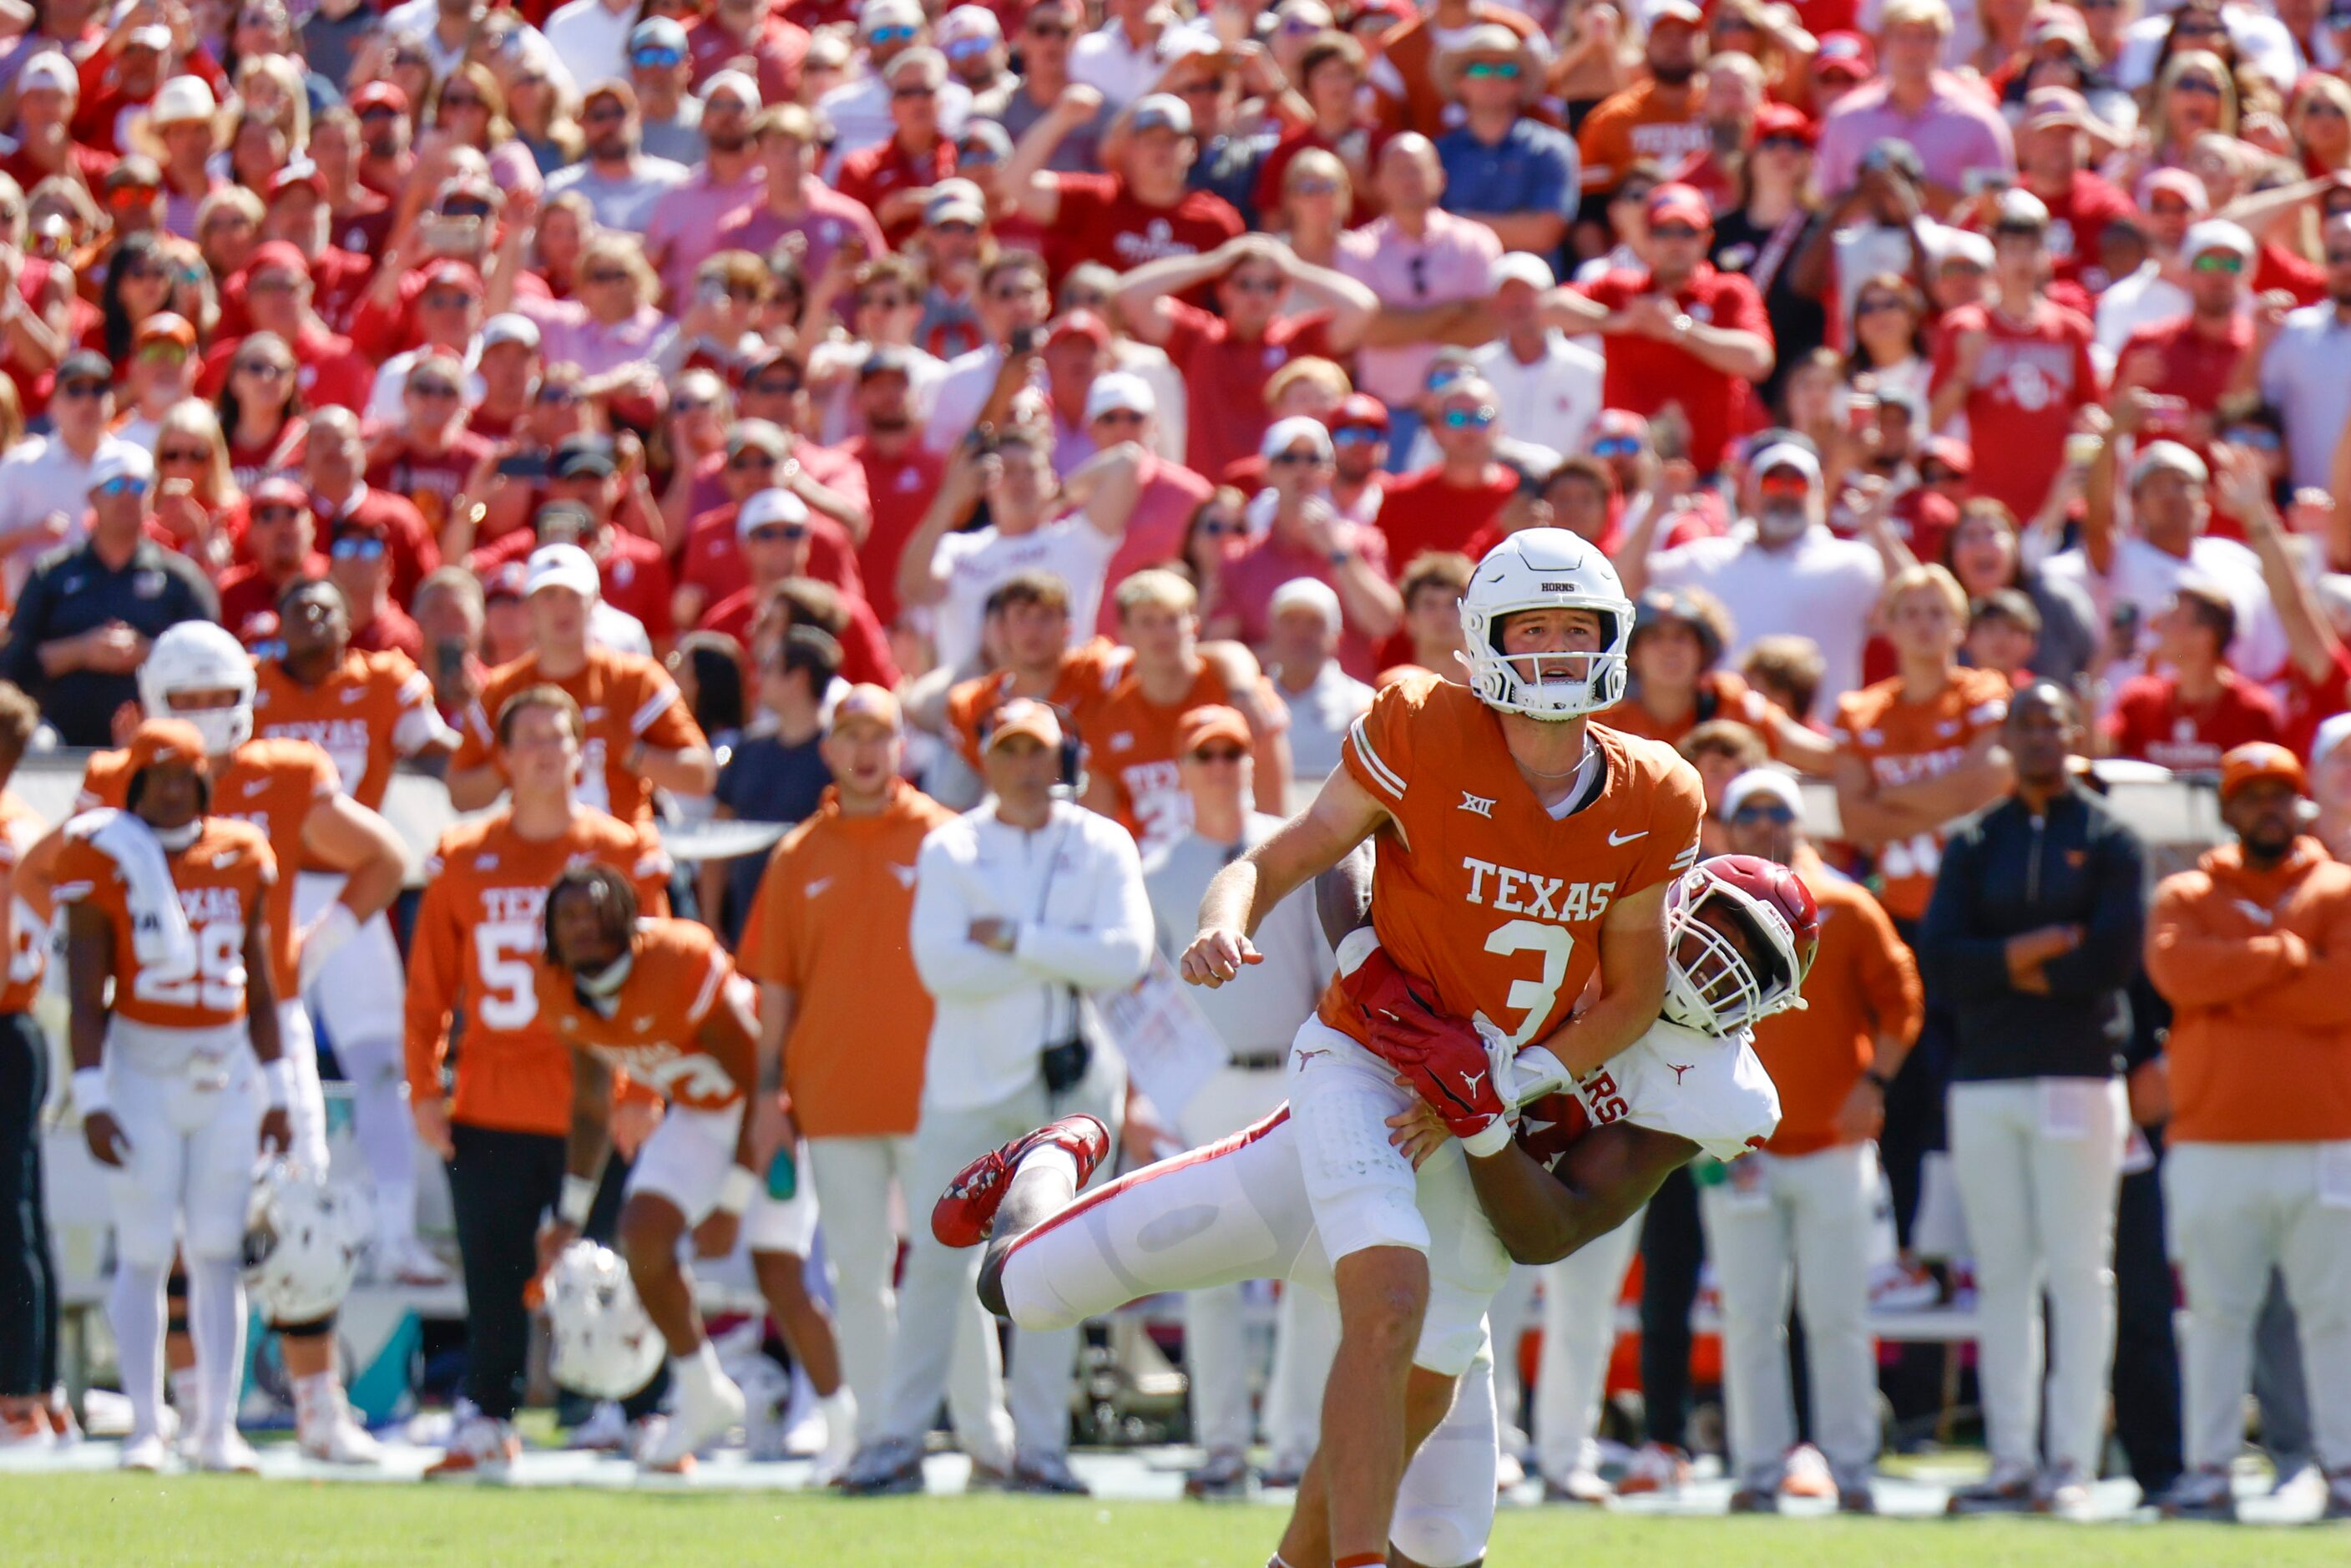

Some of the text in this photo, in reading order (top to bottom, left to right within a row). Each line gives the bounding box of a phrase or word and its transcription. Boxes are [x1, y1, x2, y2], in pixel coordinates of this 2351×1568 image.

[1541, 583, 1575, 593] HORNS
[1121, 760, 1179, 796] TEX
[1457, 791, 1497, 819] XII
[179, 888, 242, 922] XAS
[480, 887, 549, 923] TEX
[1463, 856, 1616, 922] TEXAS
[474, 921, 549, 1030] 5
[1484, 919, 1575, 1055] 3
[1580, 1064, 1629, 1125] RS
